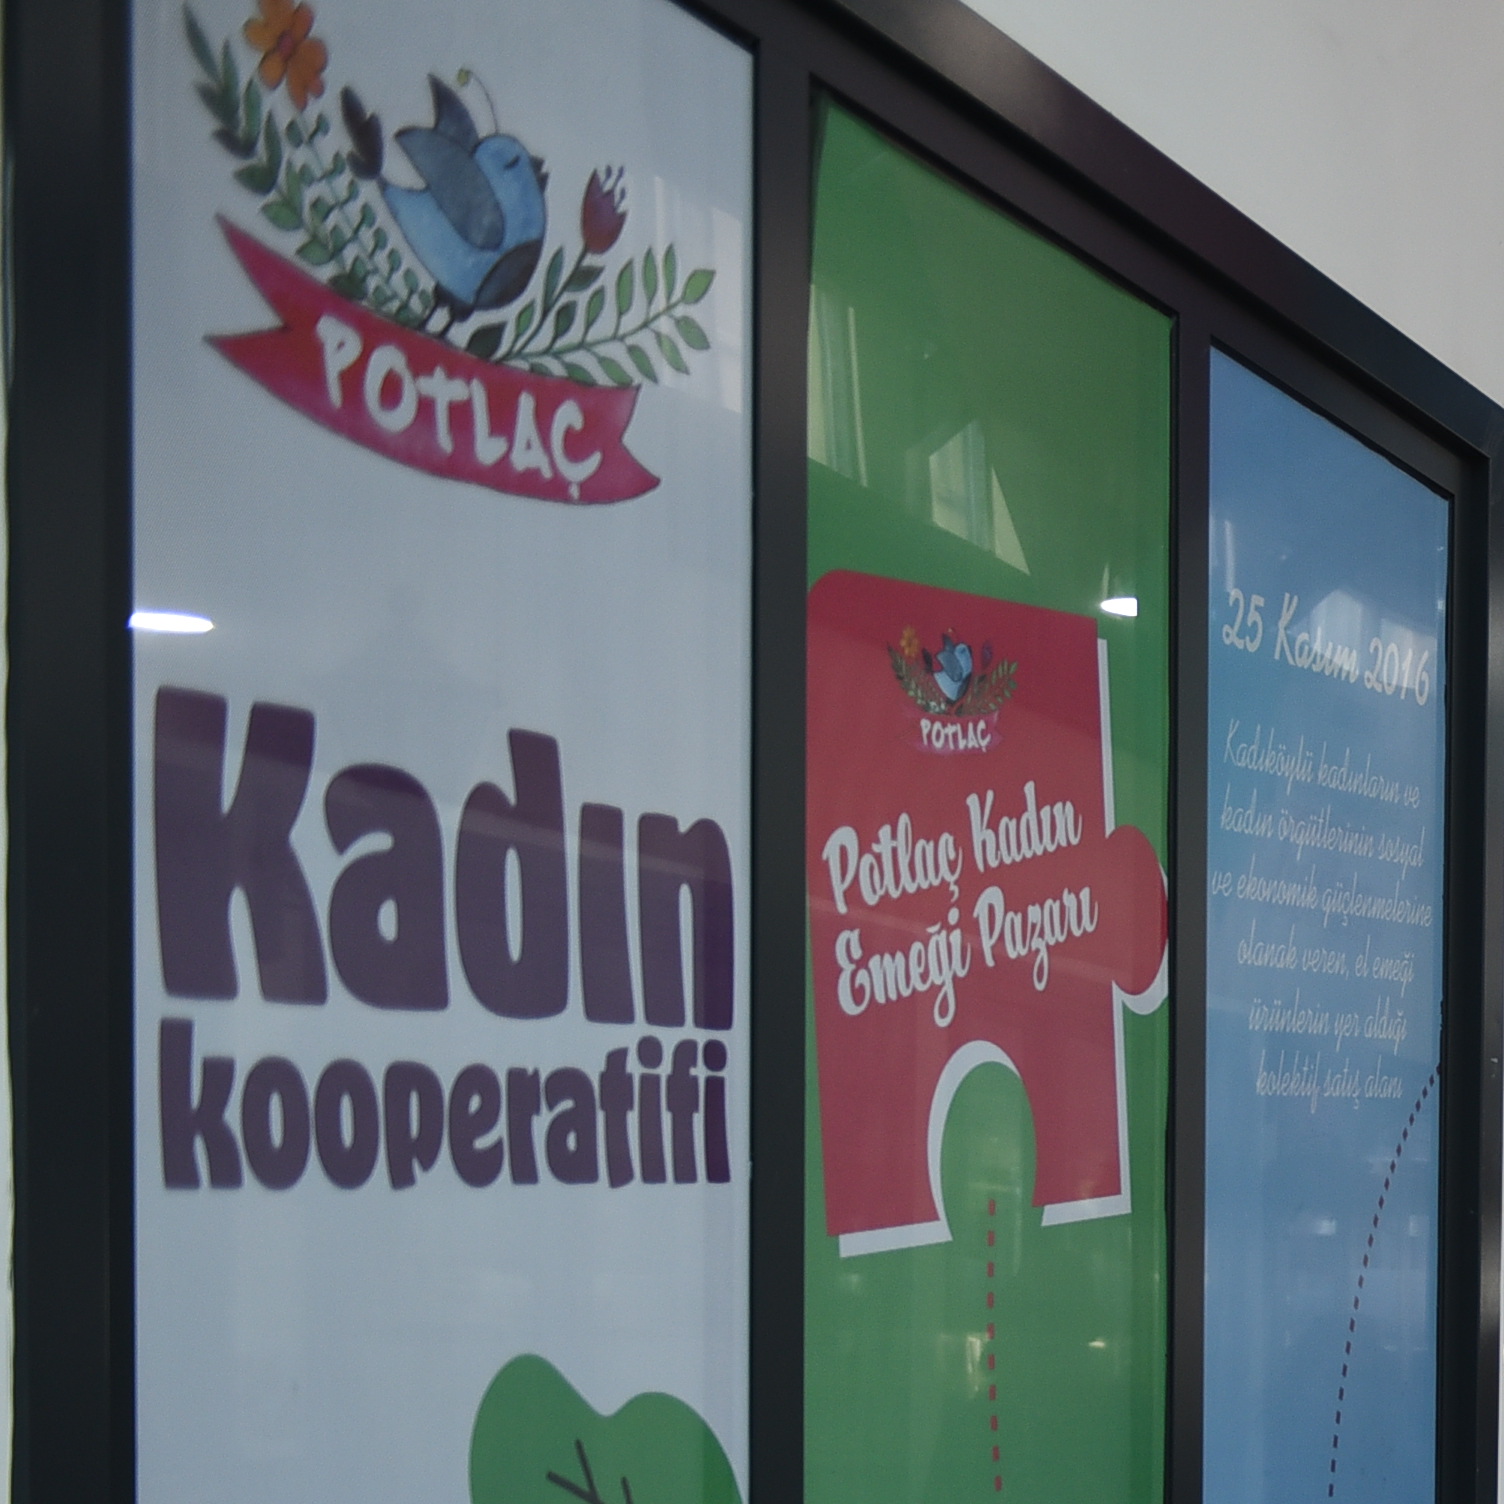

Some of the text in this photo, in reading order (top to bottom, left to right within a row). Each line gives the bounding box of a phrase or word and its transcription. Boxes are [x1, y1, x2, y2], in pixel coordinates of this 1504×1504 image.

[315, 313, 602, 500] POTLAÇ
[1222, 588, 1430, 706] 25 Kasım 2016
[919, 718, 992, 753] POTLAÇ
[1224, 718, 1420, 808] Kadıköylü kadınların ve
[153, 684, 734, 1032] Kadın
[821, 780, 1083, 914] Potlaç Kadın
[1212, 870, 1232, 896] ve
[1237, 854, 1318, 909] ekonomik
[1220, 782, 1426, 881] kadın örgütlerinin sosyal
[835, 885, 1099, 1028] Emeği Pazarı
[1237, 918, 1298, 969] olanak
[1354, 934, 1371, 978] el
[1372, 952, 1415, 997] emeği
[1248, 987, 1330, 1035] ürünlerin
[1334, 1011, 1360, 1052] yer
[159, 1015, 731, 1191] kooperatifi
